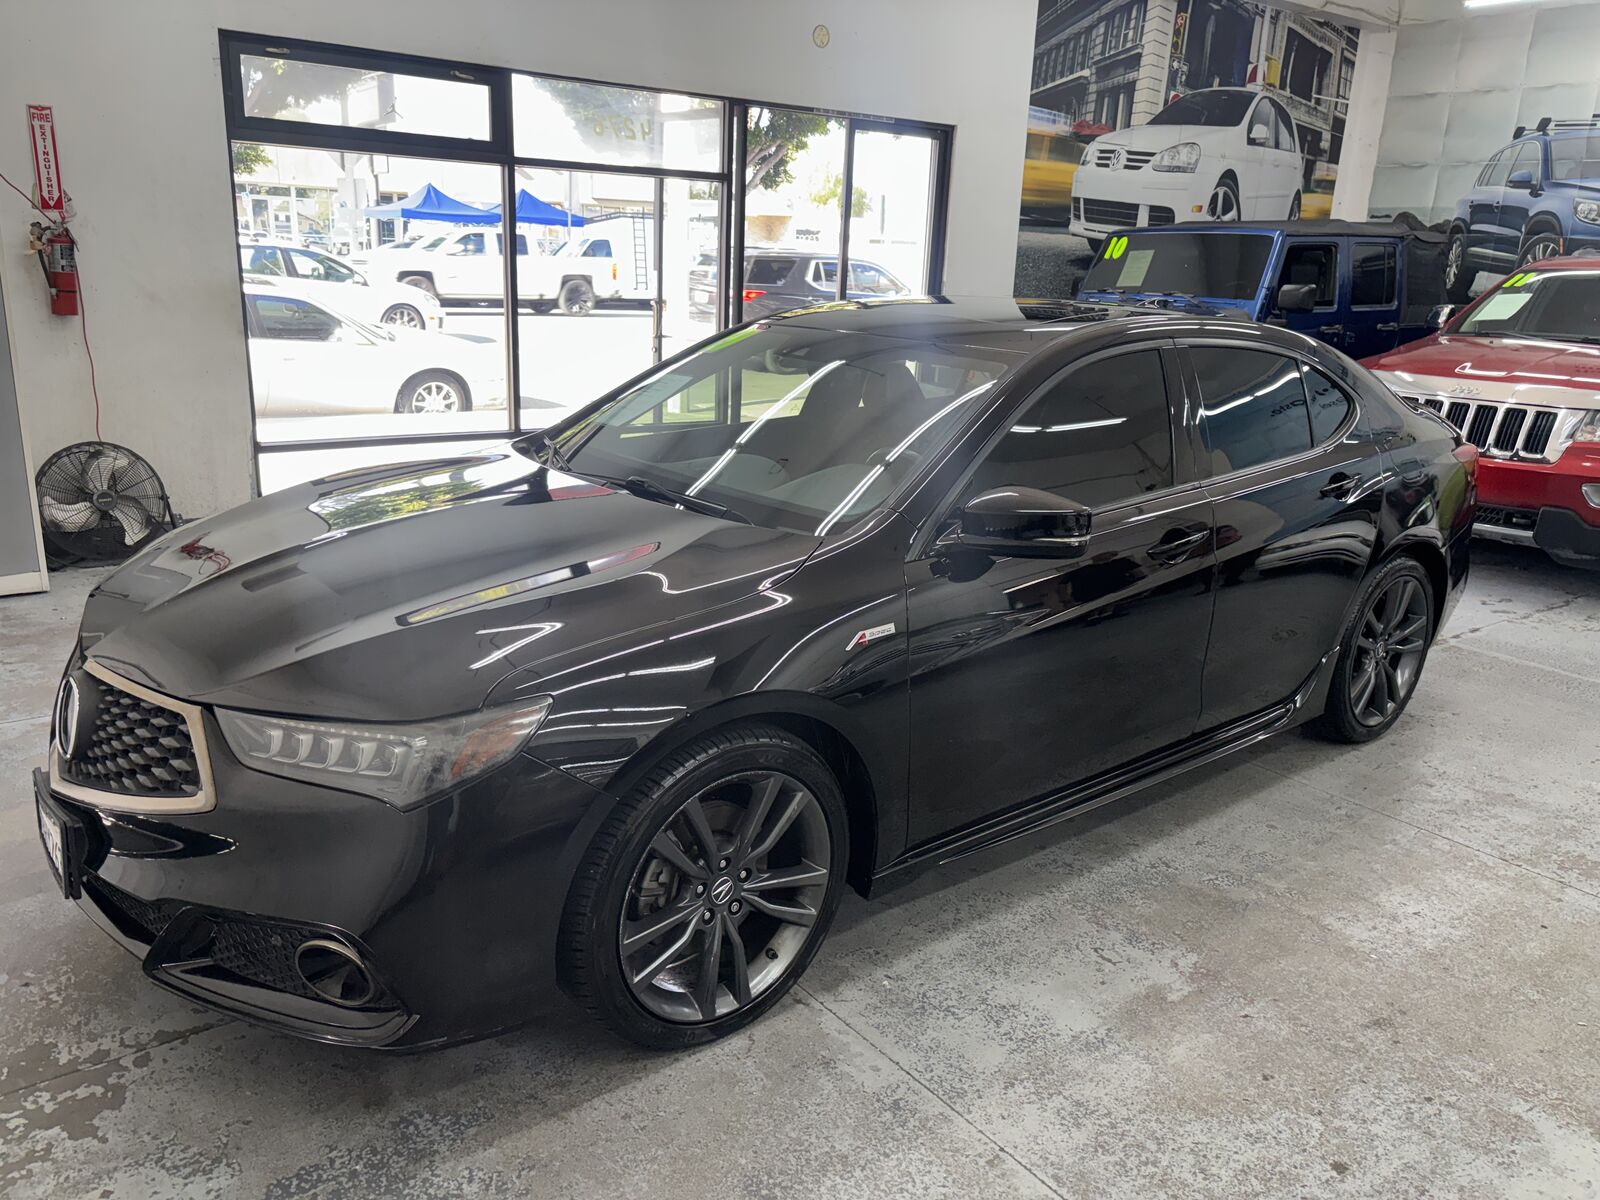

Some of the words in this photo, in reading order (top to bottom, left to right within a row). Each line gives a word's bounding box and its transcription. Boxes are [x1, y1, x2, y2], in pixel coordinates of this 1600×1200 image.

[31, 112, 51, 123] FIRE
[39, 124, 54, 202] EXTINGUISHER
[1104, 236, 1129, 260] 10
[1503, 273, 1536, 287] 11
